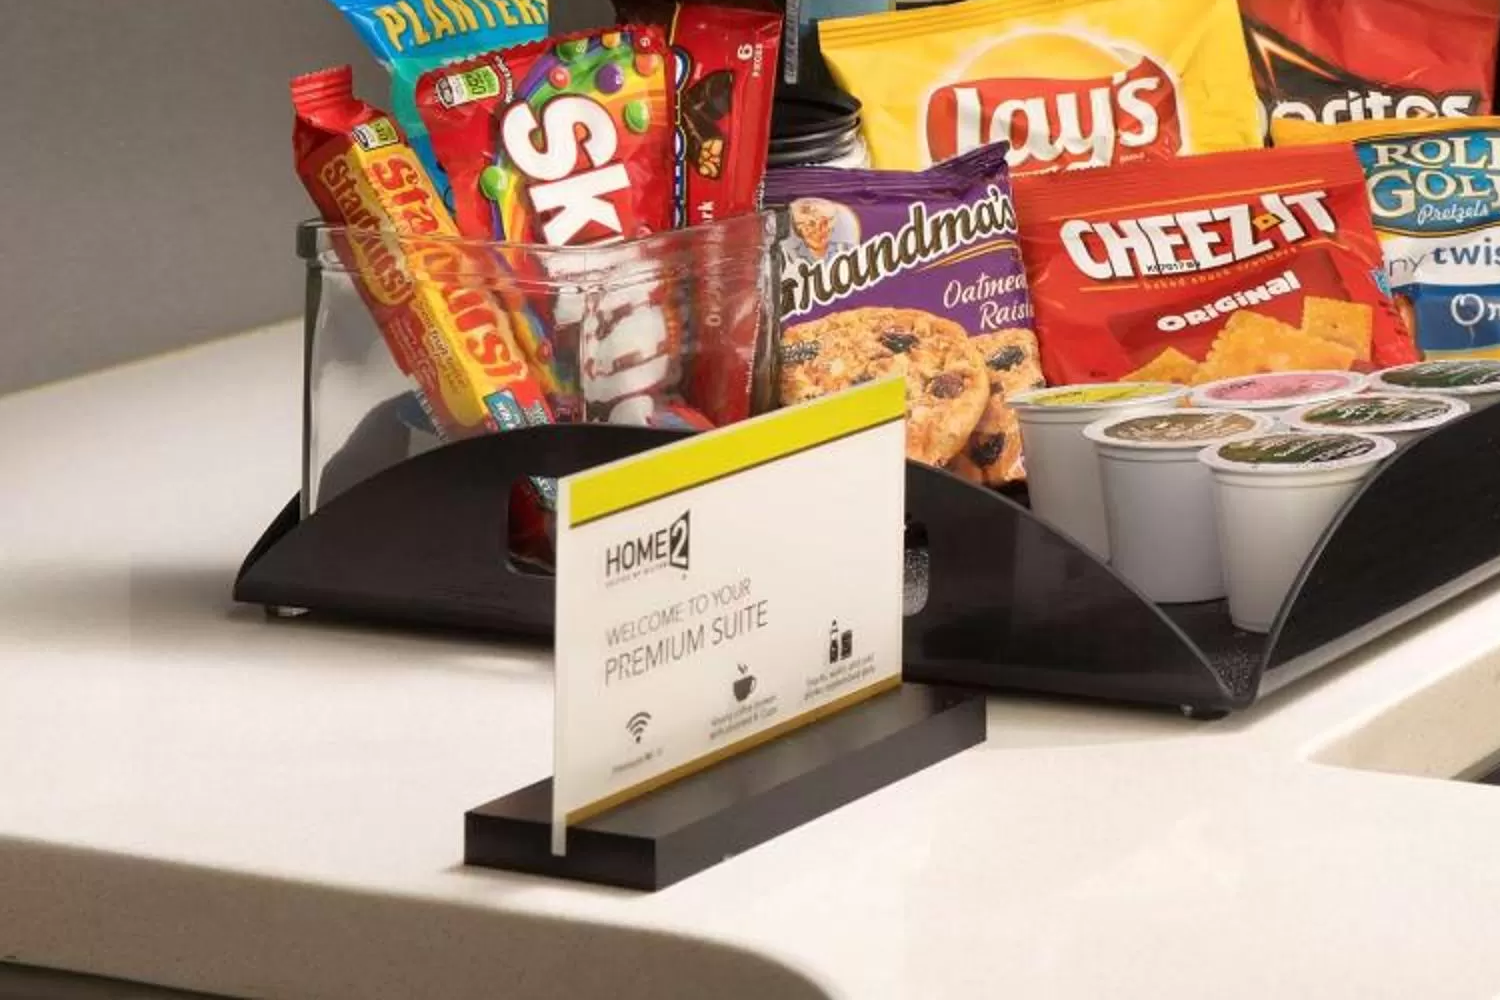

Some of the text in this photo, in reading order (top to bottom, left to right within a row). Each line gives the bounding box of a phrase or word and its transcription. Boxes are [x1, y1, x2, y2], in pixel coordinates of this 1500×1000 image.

[954, 72, 1161, 168] Lay's
[1258, 87, 1473, 126] oritos
[1416, 199, 1490, 225] Pretzels
[370, 158, 526, 379] Starburst
[943, 272, 1028, 308] Oatmea
[1389, 253, 1428, 277] ny
[605, 576, 752, 648] WELCOME TO YOUR
[604, 599, 769, 688] PREMIUM SUITE
